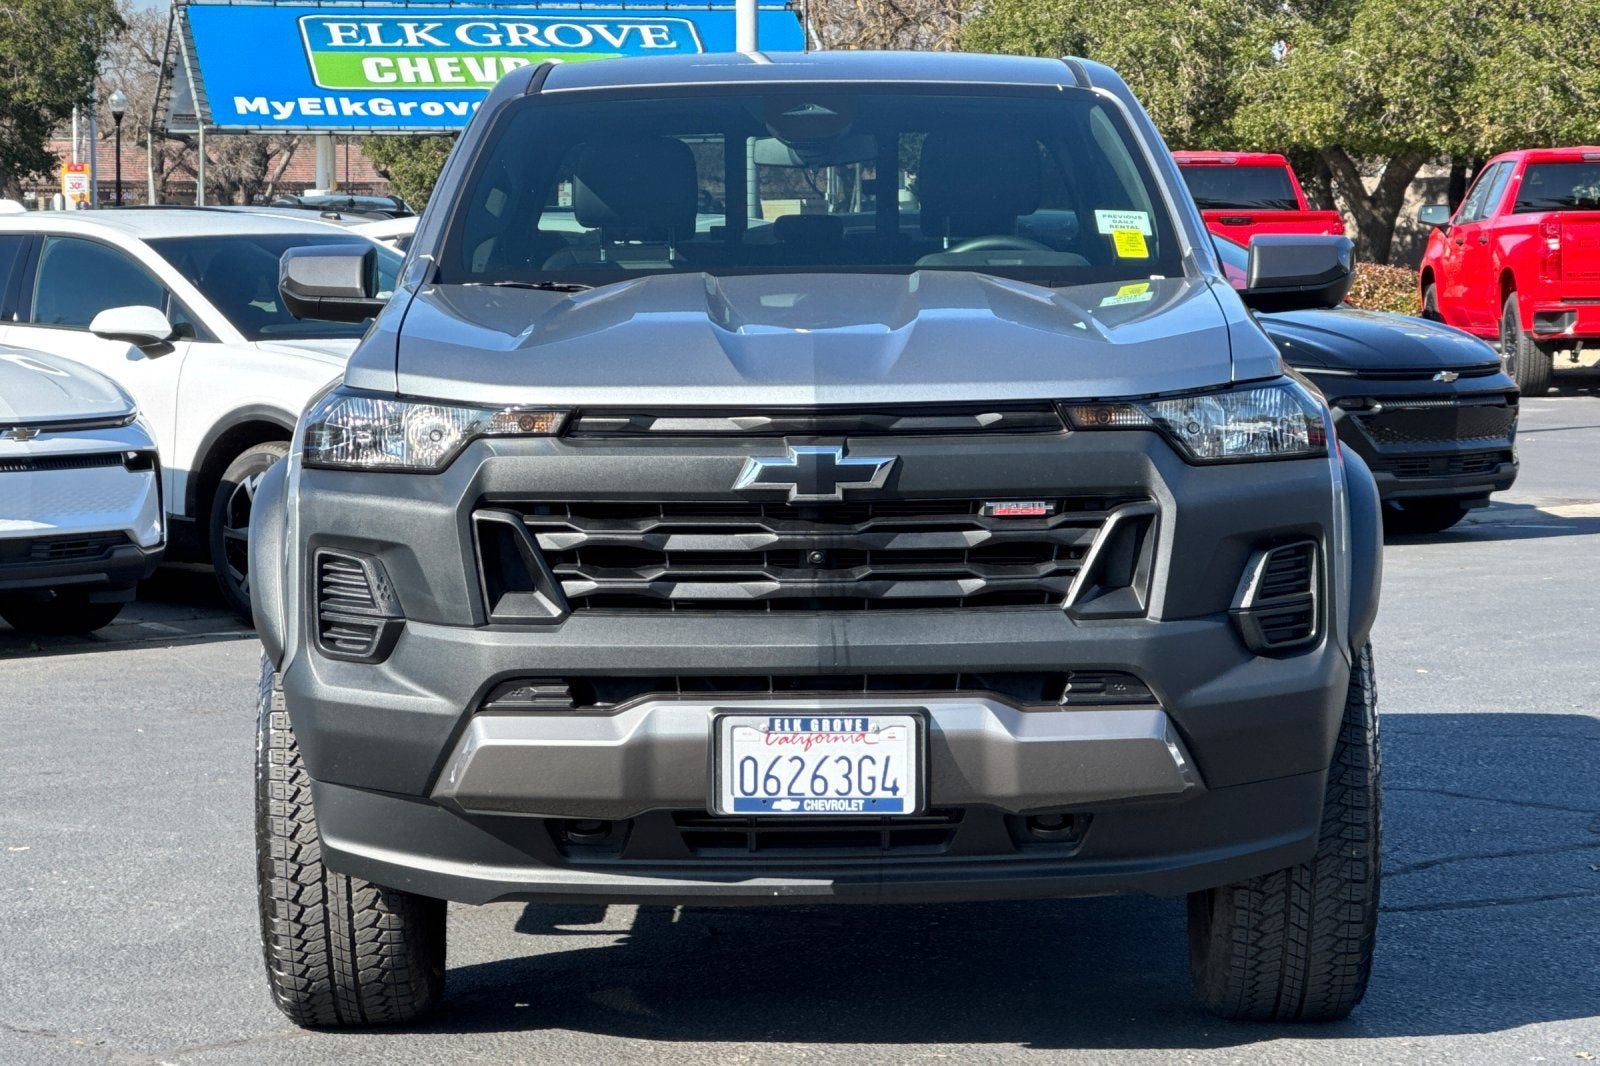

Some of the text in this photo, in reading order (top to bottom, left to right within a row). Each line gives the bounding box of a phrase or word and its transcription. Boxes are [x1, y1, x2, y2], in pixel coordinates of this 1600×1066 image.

[323, 22, 677, 48] ELK GROVE
[362, 57, 565, 83] CHEV
[774, 719, 862, 732] ELK GROVE
[765, 733, 880, 751] California
[739, 755, 899, 796] 06263G4
[803, 799, 865, 811] CHEVROLET
